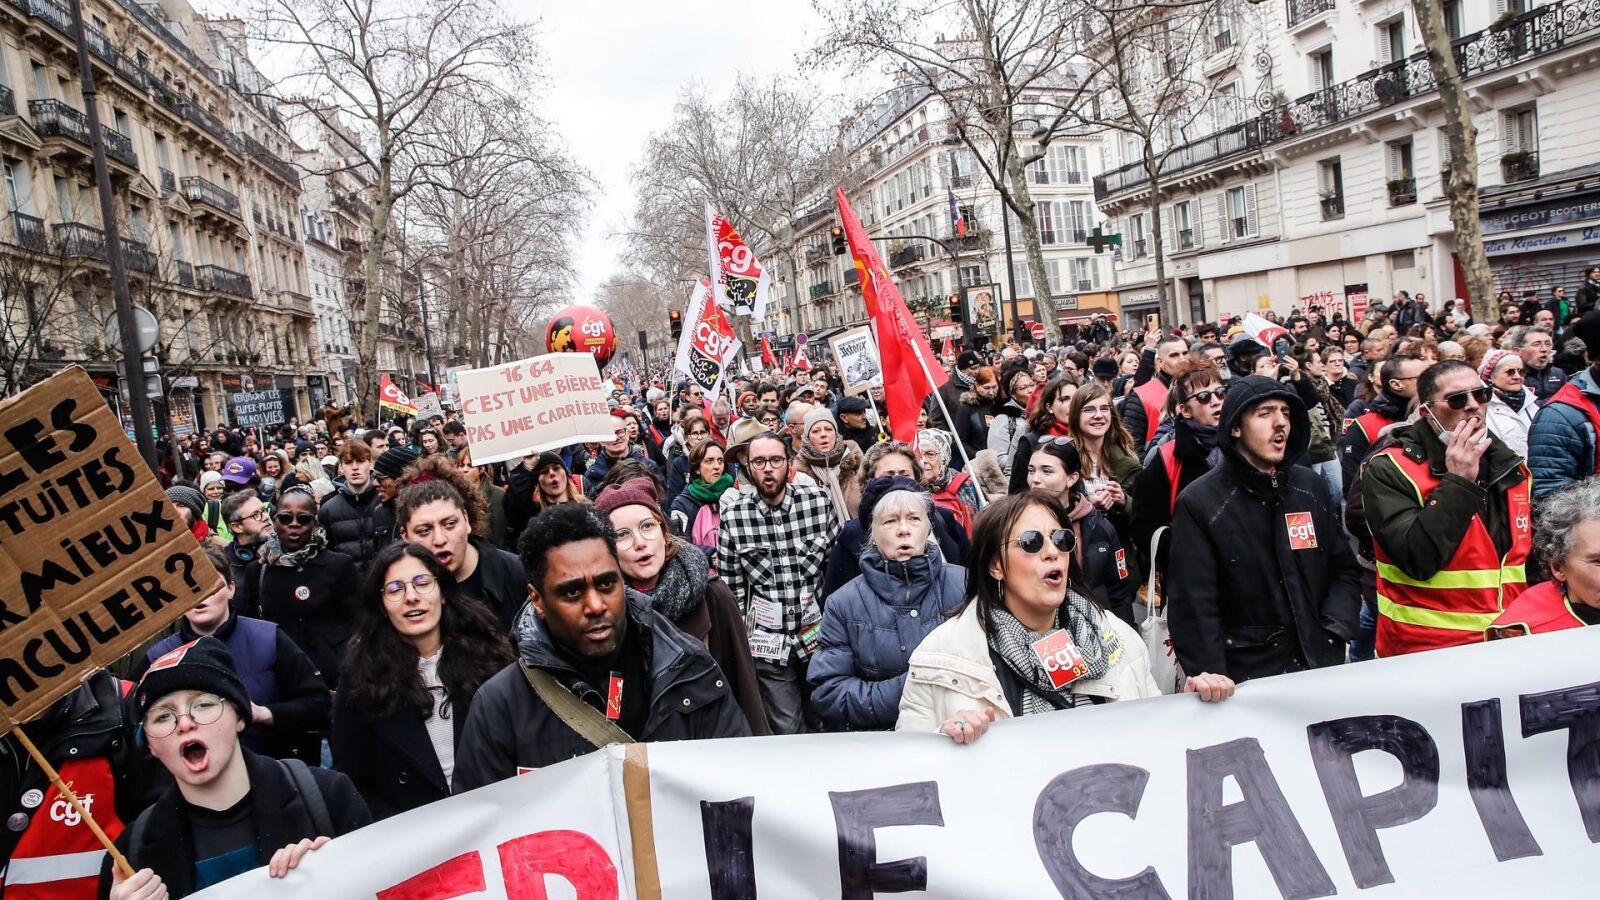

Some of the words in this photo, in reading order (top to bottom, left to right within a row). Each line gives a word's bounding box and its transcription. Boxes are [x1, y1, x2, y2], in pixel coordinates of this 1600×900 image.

[1484, 243, 1506, 253] elier
[581, 320, 606, 337] cgt
[501, 364, 523, 383] 16
[530, 360, 555, 379] 64
[463, 390, 516, 415] C'EST
[519, 382, 555, 404] UNE
[466, 423, 496, 444] PAS
[500, 415, 535, 437] UNE
[1289, 522, 1315, 540] cgt
[757, 644, 780, 655] RETRAIT
[1044, 643, 1081, 672] cgt
[1073, 663, 1087, 676] 93
[50, 794, 93, 826] cgt
